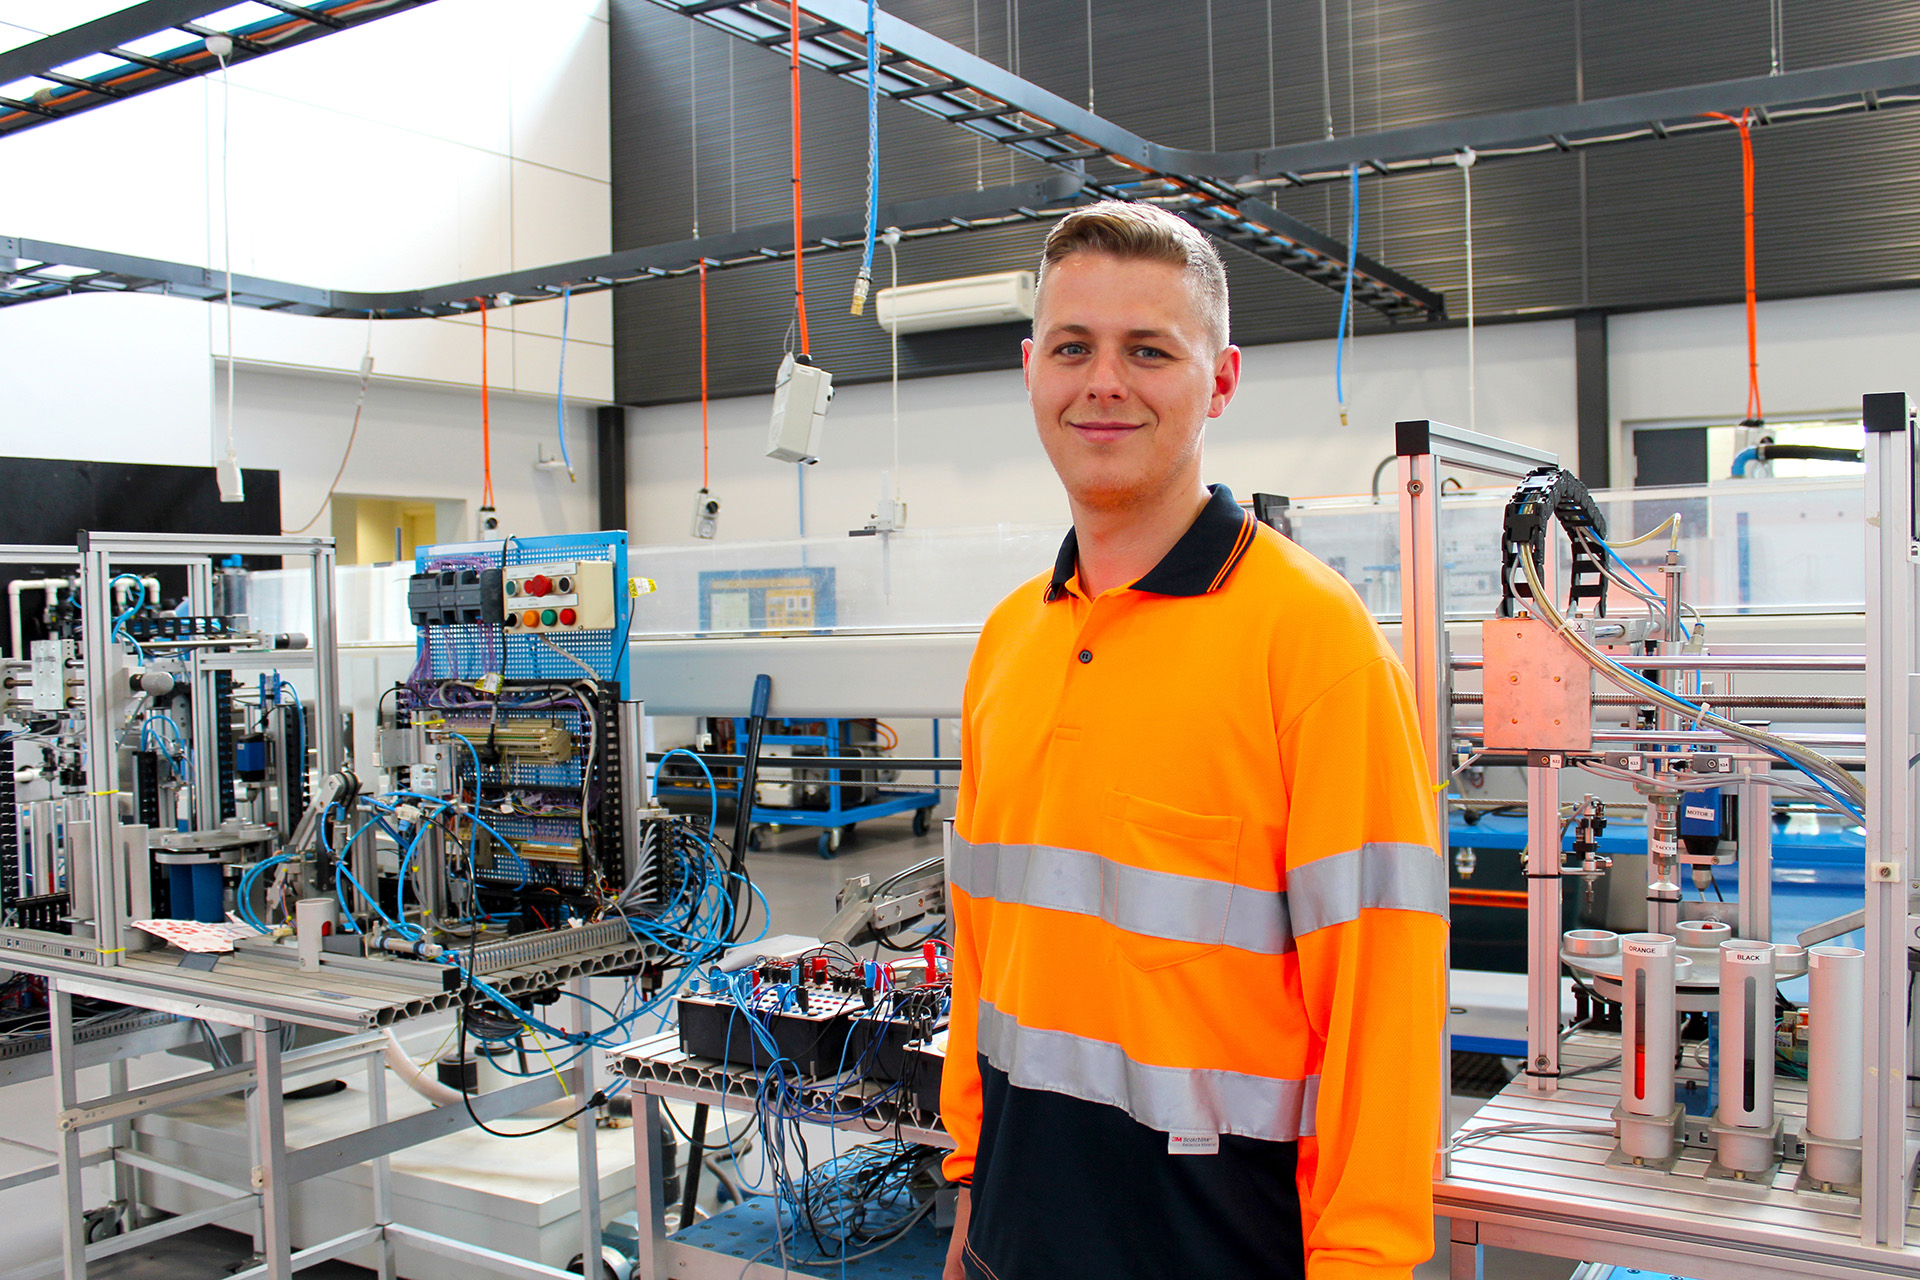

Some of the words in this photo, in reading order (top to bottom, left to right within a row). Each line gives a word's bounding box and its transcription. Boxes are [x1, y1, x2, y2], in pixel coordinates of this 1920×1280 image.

[1577, 622, 1583, 630] X
[1687, 809, 1709, 817] MOTOR
[1629, 945, 1656, 954] ORANGE
